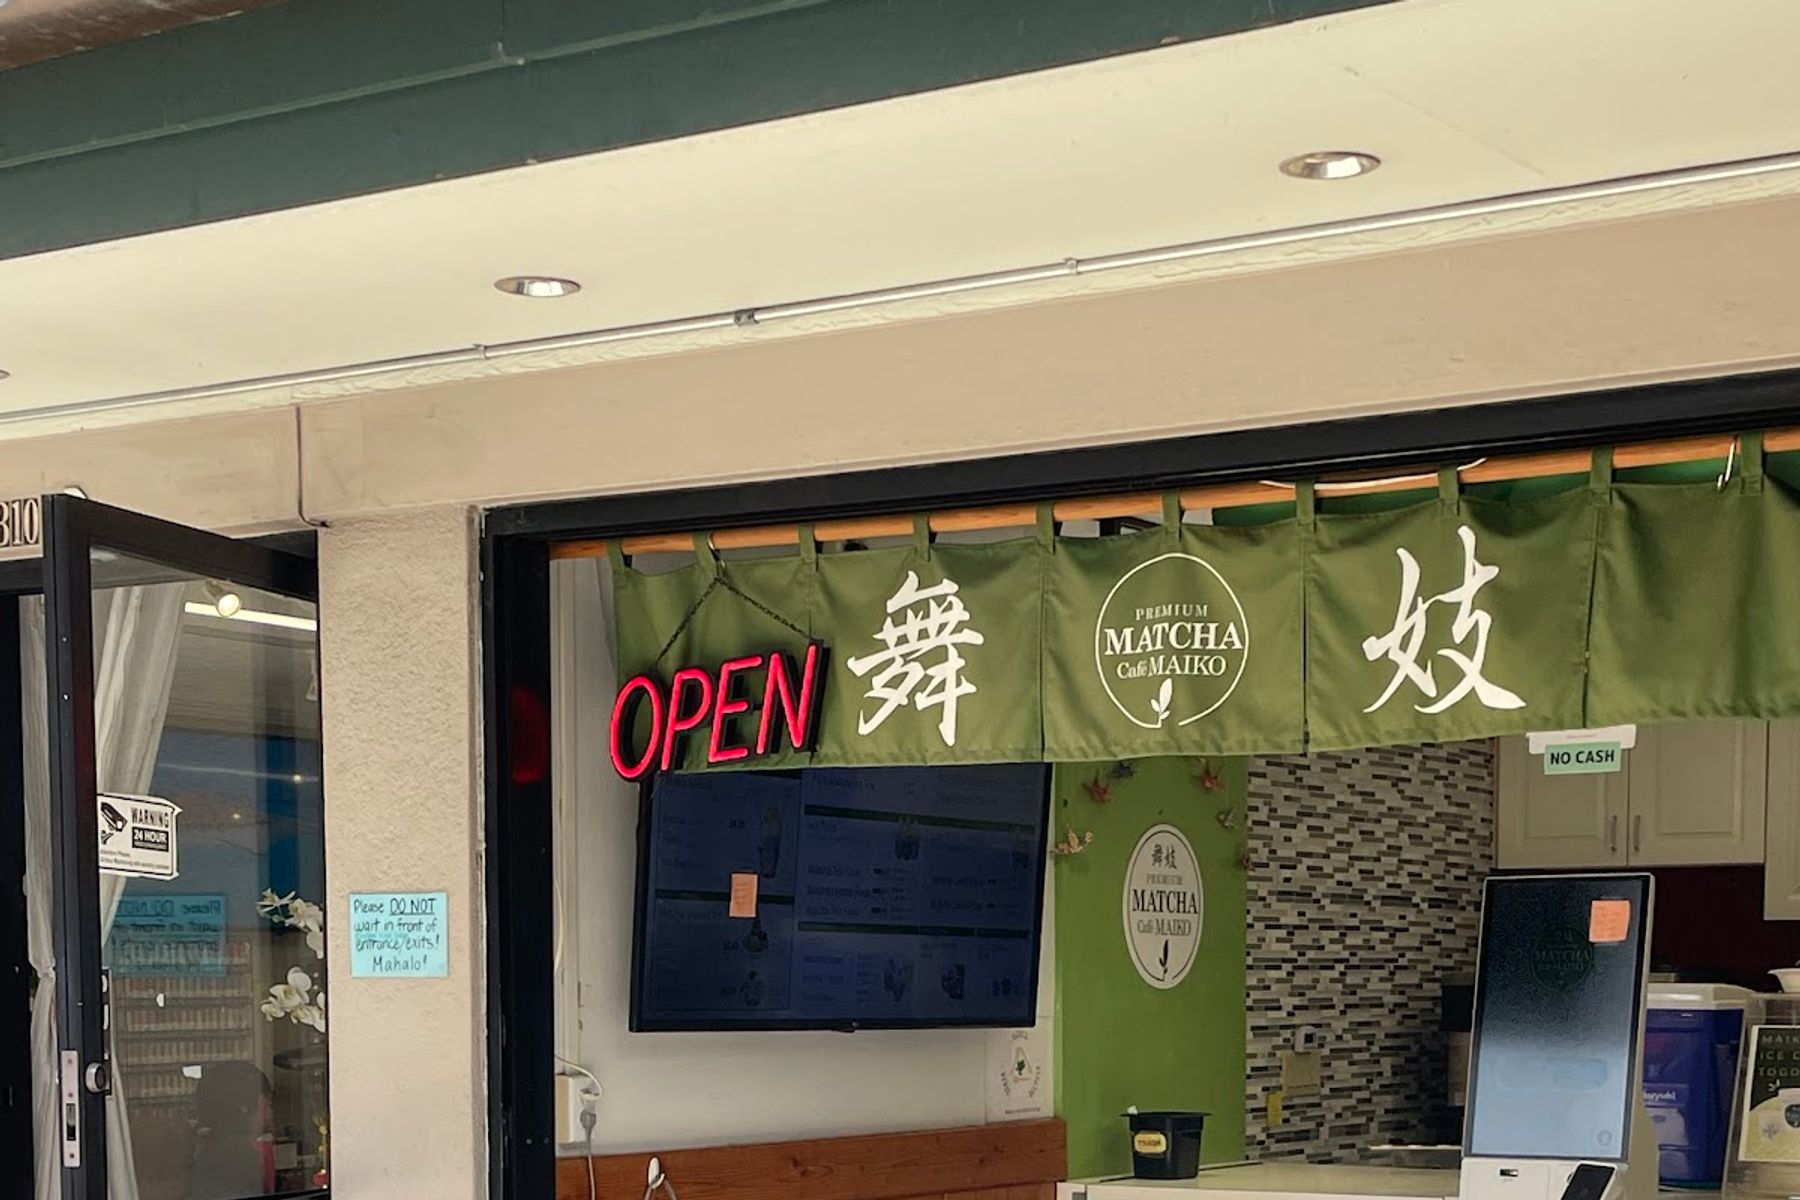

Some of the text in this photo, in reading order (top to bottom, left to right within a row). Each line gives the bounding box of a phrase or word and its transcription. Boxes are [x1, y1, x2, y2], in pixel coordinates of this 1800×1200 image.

[1135, 603, 1208, 621] PREMIUM
[1362, 525, 1526, 714] 妓
[1104, 622, 1244, 655] MATCHA
[847, 570, 984, 746] 舞
[1116, 655, 1227, 679] Café MAIKO
[610, 643, 818, 779] OPEN
[1550, 749, 1615, 765] NO CASH
[131, 807, 169, 829] WARNING
[133, 829, 168, 843] 24 HOUR
[1146, 873, 1184, 886] PREMIUM
[354, 897, 437, 914] Please DO NOT
[1132, 888, 1200, 915] MATCHA
[354, 917, 437, 933] wait in front of
[1154, 918, 1192, 937] MAIKO
[372, 954, 427, 972] Mahalo!
